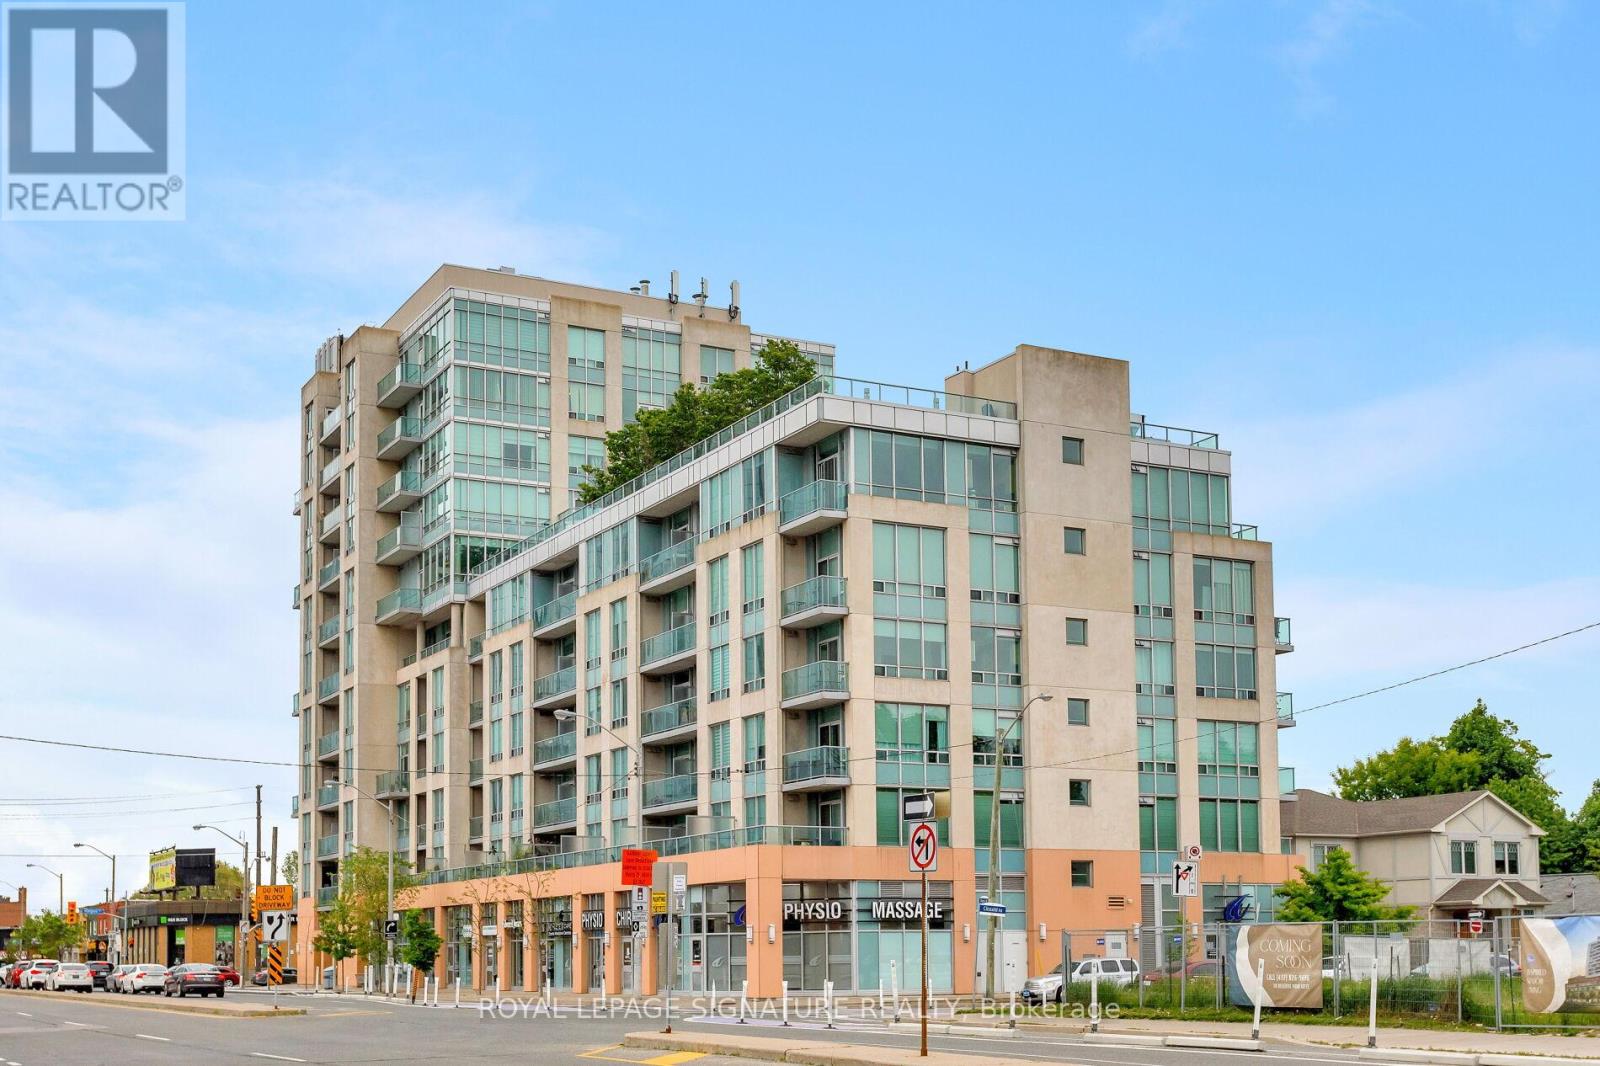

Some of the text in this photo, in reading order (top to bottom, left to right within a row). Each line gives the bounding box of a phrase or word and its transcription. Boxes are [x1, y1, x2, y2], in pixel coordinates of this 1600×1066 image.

[784, 901, 842, 920] PHYSIO
[872, 901, 943, 919] MASSAGE
[582, 912, 603, 928] PHYSIO
[1260, 939, 1311, 953] COMING
[1275, 955, 1313, 969] SOON
